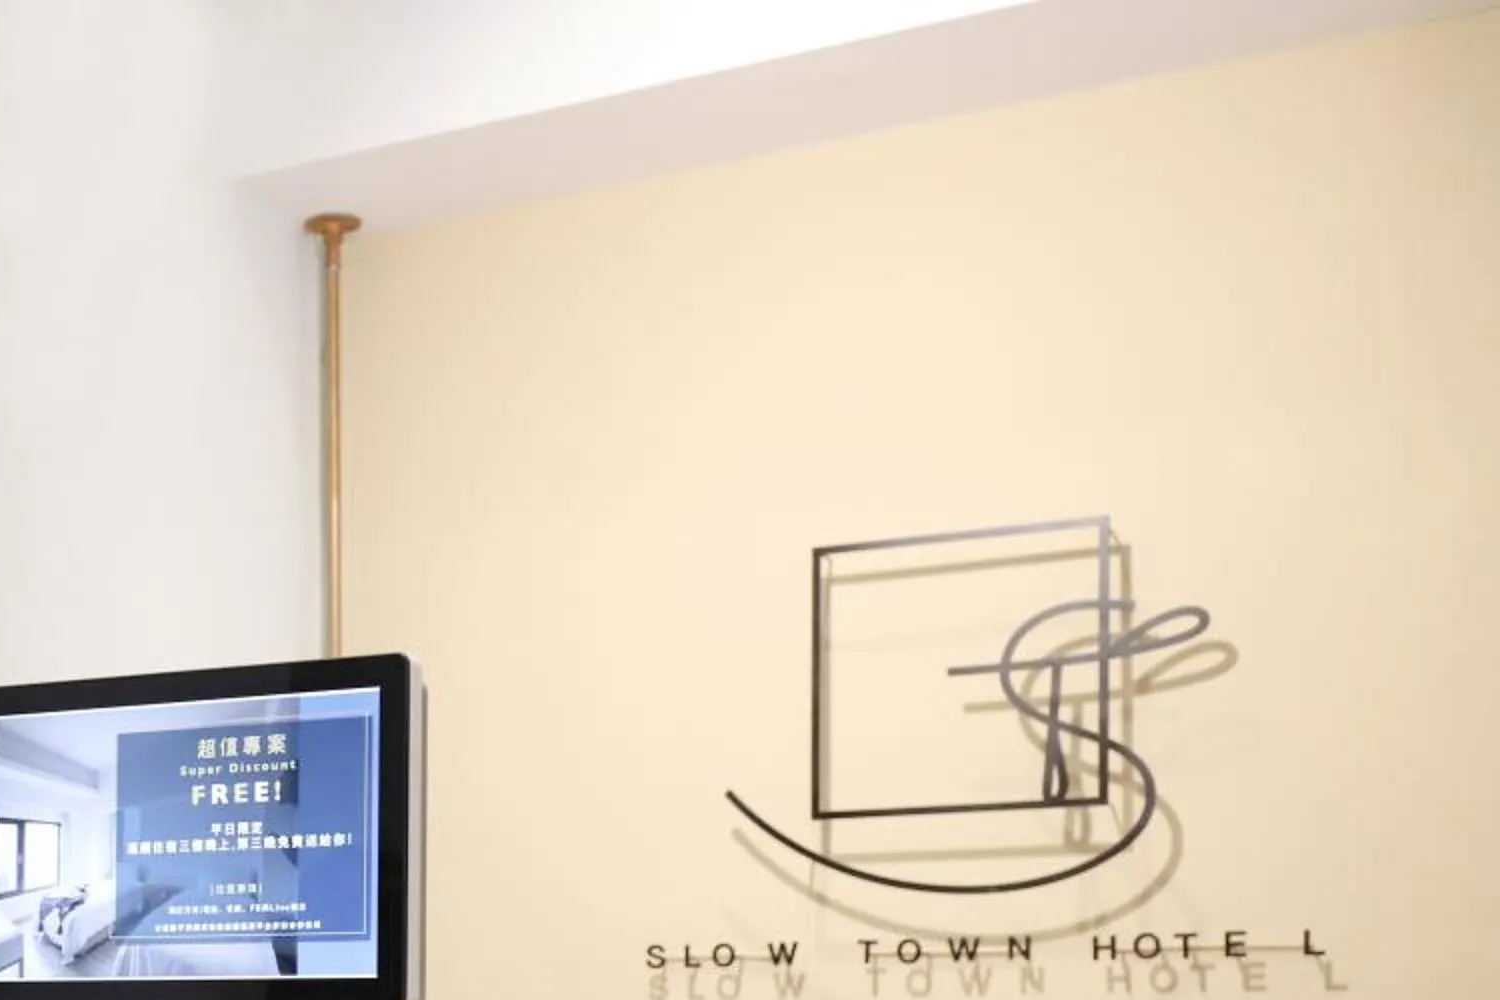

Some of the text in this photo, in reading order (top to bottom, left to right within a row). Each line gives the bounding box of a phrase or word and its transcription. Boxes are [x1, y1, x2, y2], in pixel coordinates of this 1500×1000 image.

[197, 733, 288, 759] 超值專案
[180, 759, 297, 777] Super Discount
[190, 779, 283, 806] FREE!
[645, 928, 1326, 969] SLOW TOWN HOTEL
